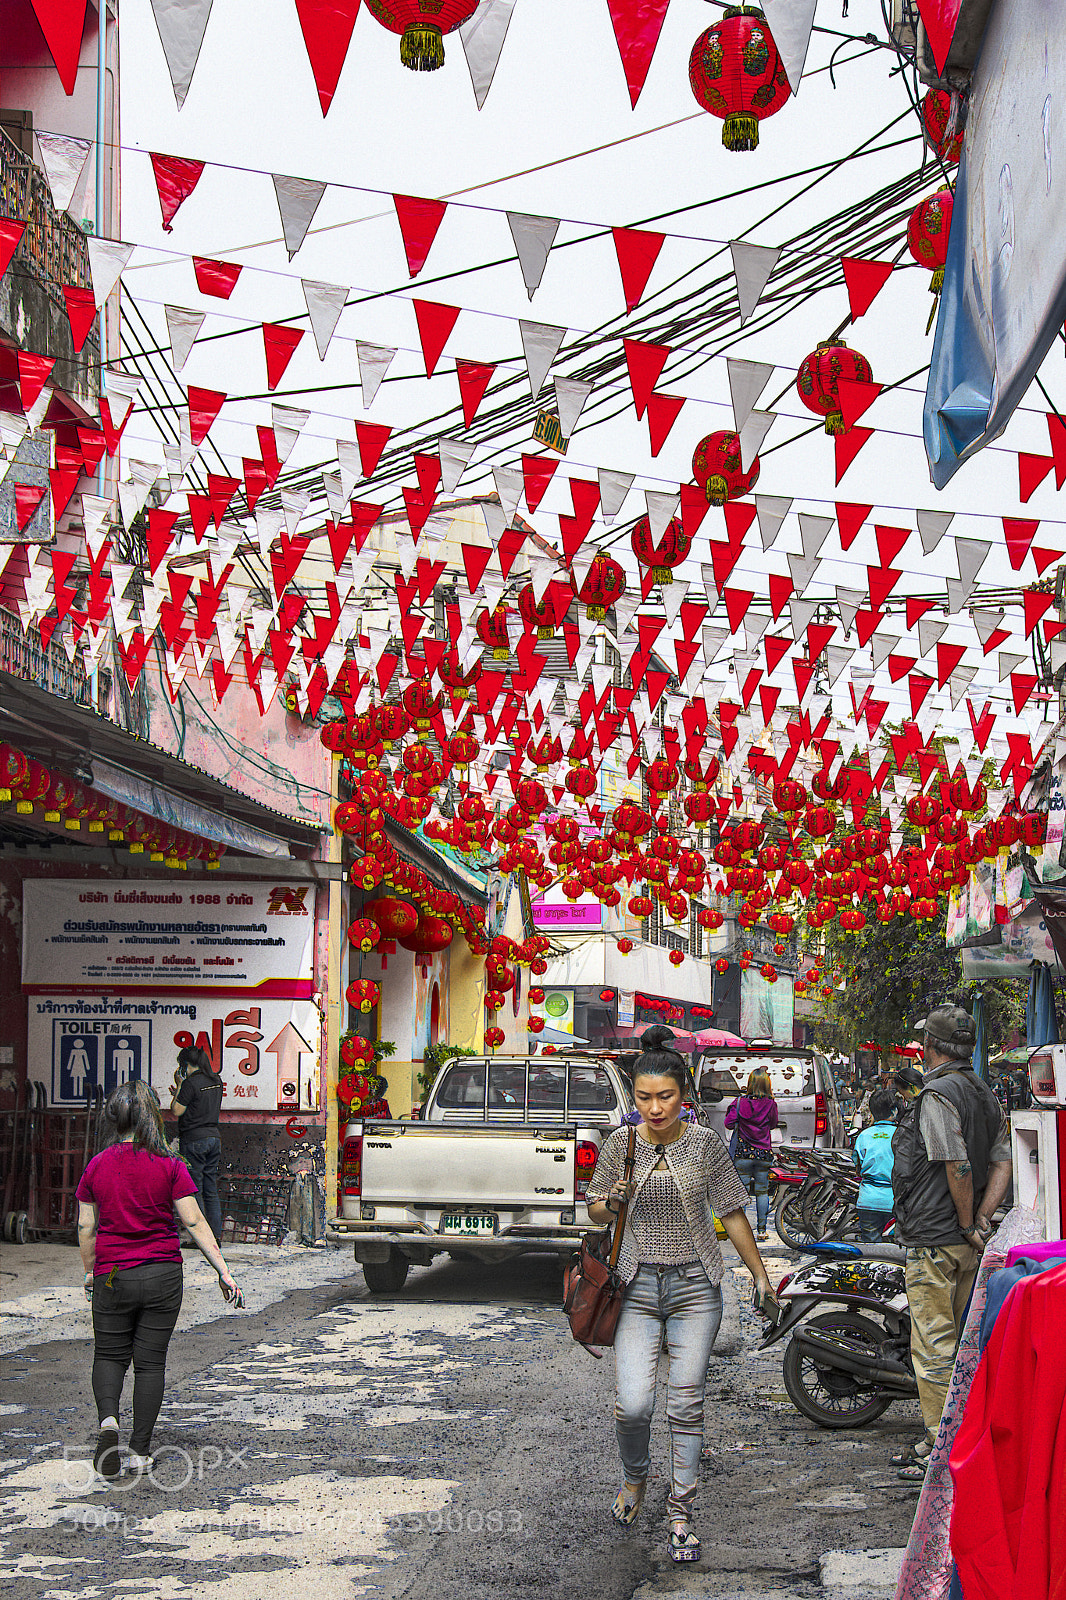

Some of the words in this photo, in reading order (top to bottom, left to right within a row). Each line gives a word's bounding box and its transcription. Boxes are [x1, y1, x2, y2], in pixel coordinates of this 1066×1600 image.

[79, 892, 108, 903] บริษัท
[189, 894, 221, 904] 1988
[226, 893, 254, 905] จำกัด
[36, 997, 197, 1020] บริการห้องน้ำที่ศาลเจ้ากวนอู
[60, 1022, 110, 1034] TOILET
[173, 1007, 264, 1076] ฟรี
[465, 1216, 493, 1229] 6913
